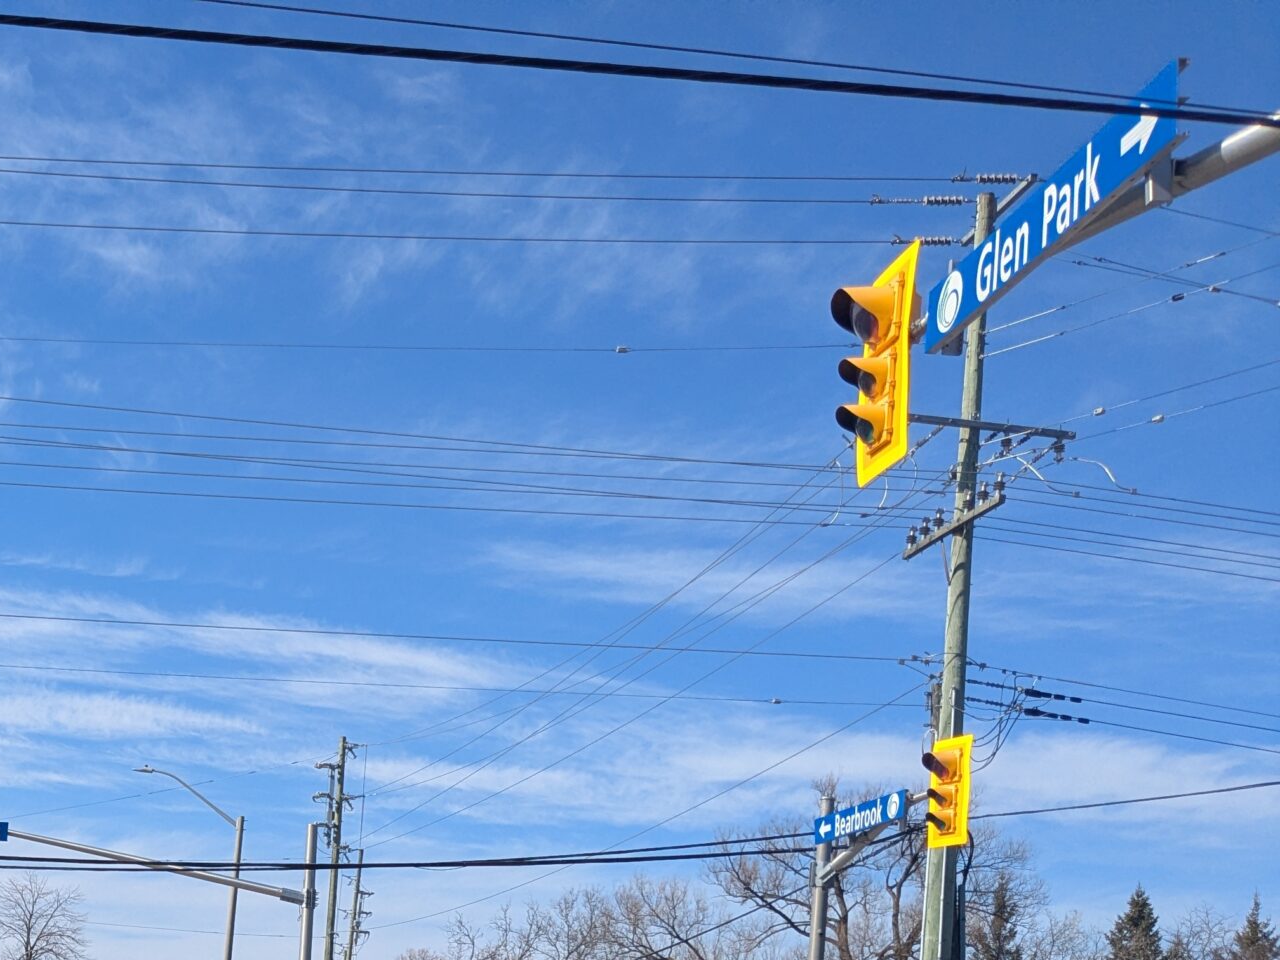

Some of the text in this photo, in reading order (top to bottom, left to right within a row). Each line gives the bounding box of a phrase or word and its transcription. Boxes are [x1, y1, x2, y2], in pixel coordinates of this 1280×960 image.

[976, 141, 1101, 302] Glen Park
[834, 799, 882, 837] Bearbrook
